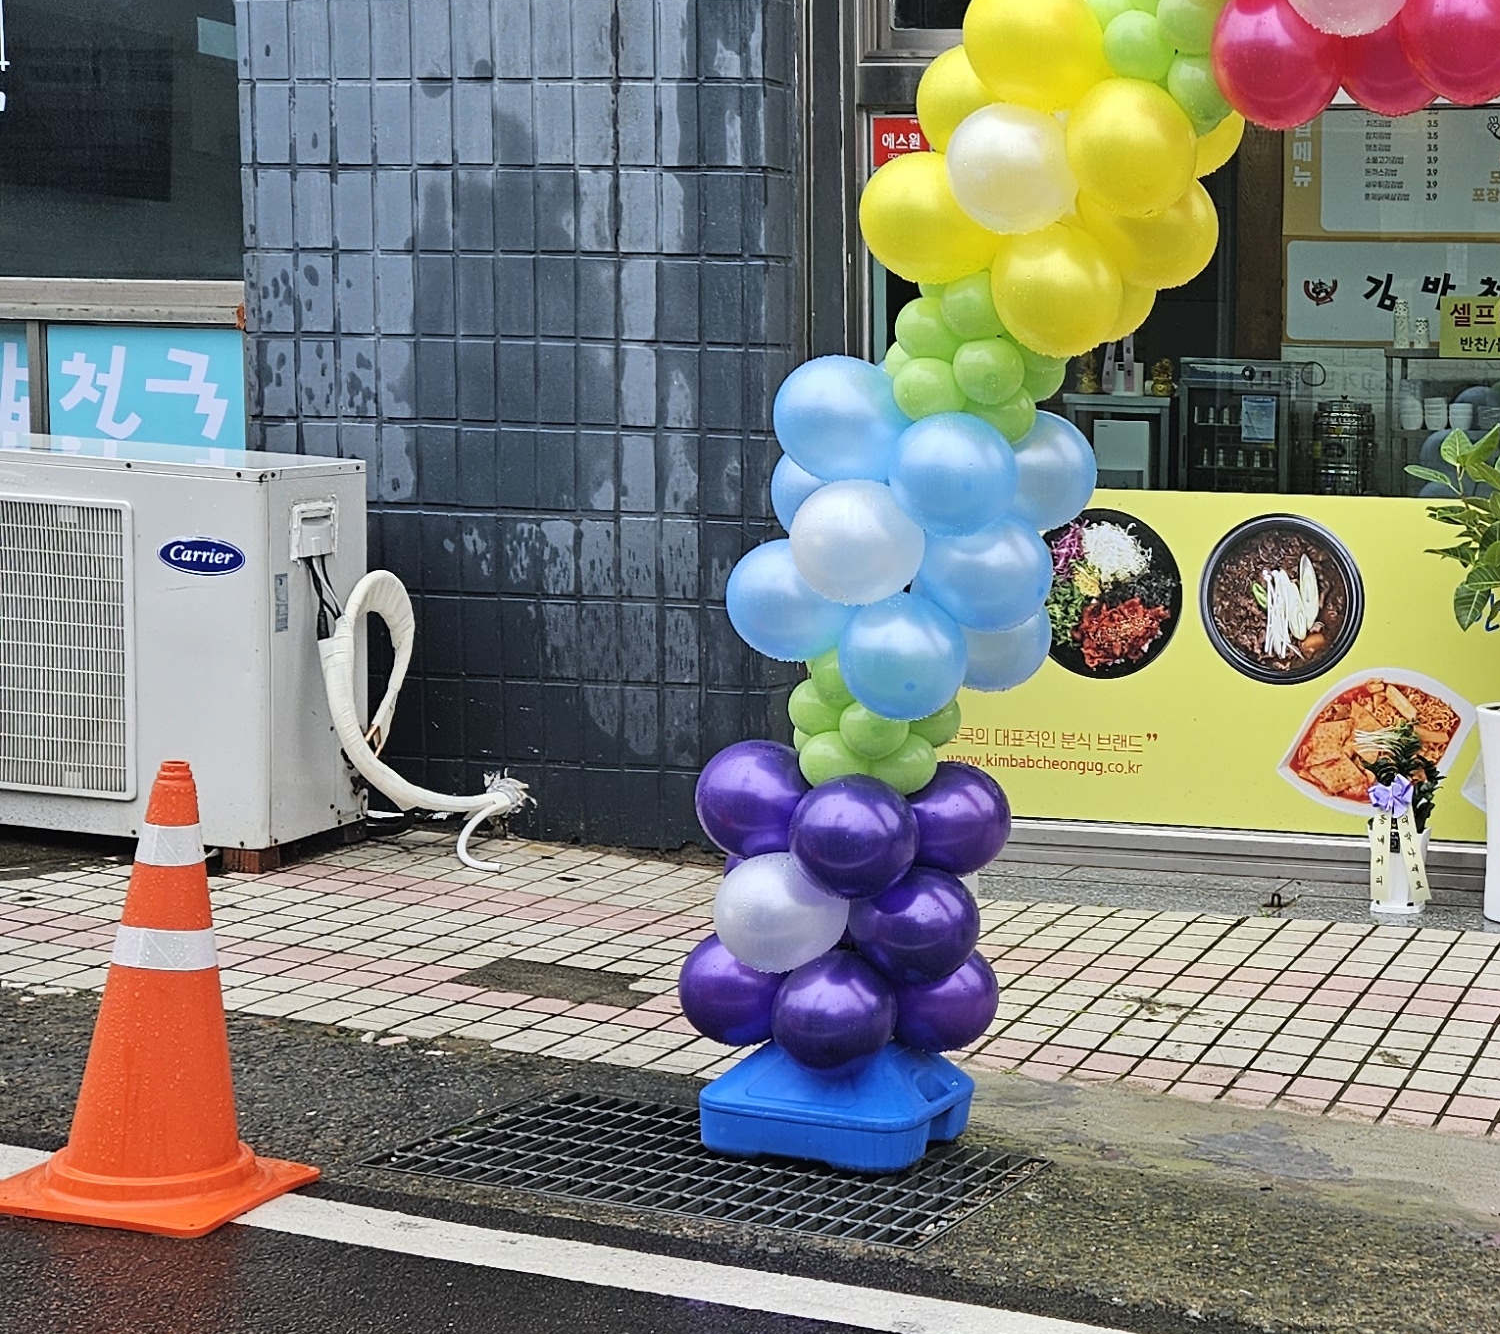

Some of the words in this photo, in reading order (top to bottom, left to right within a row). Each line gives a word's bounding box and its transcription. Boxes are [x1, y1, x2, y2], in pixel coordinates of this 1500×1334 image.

[1427, 120, 1438, 128] 3.5
[1427, 132, 1438, 140] 3.5
[881, 132, 920, 150] 에스원
[1427, 144, 1438, 152] 3.5
[1427, 156, 1438, 164] 3.9
[1426, 168, 1438, 176] 3.9
[1425, 193, 1437, 201] 3.9
[169, 544, 234, 566] Carrier
[995, 728, 1056, 749] 대표적인
[1060, 732, 1091, 750] 분식
